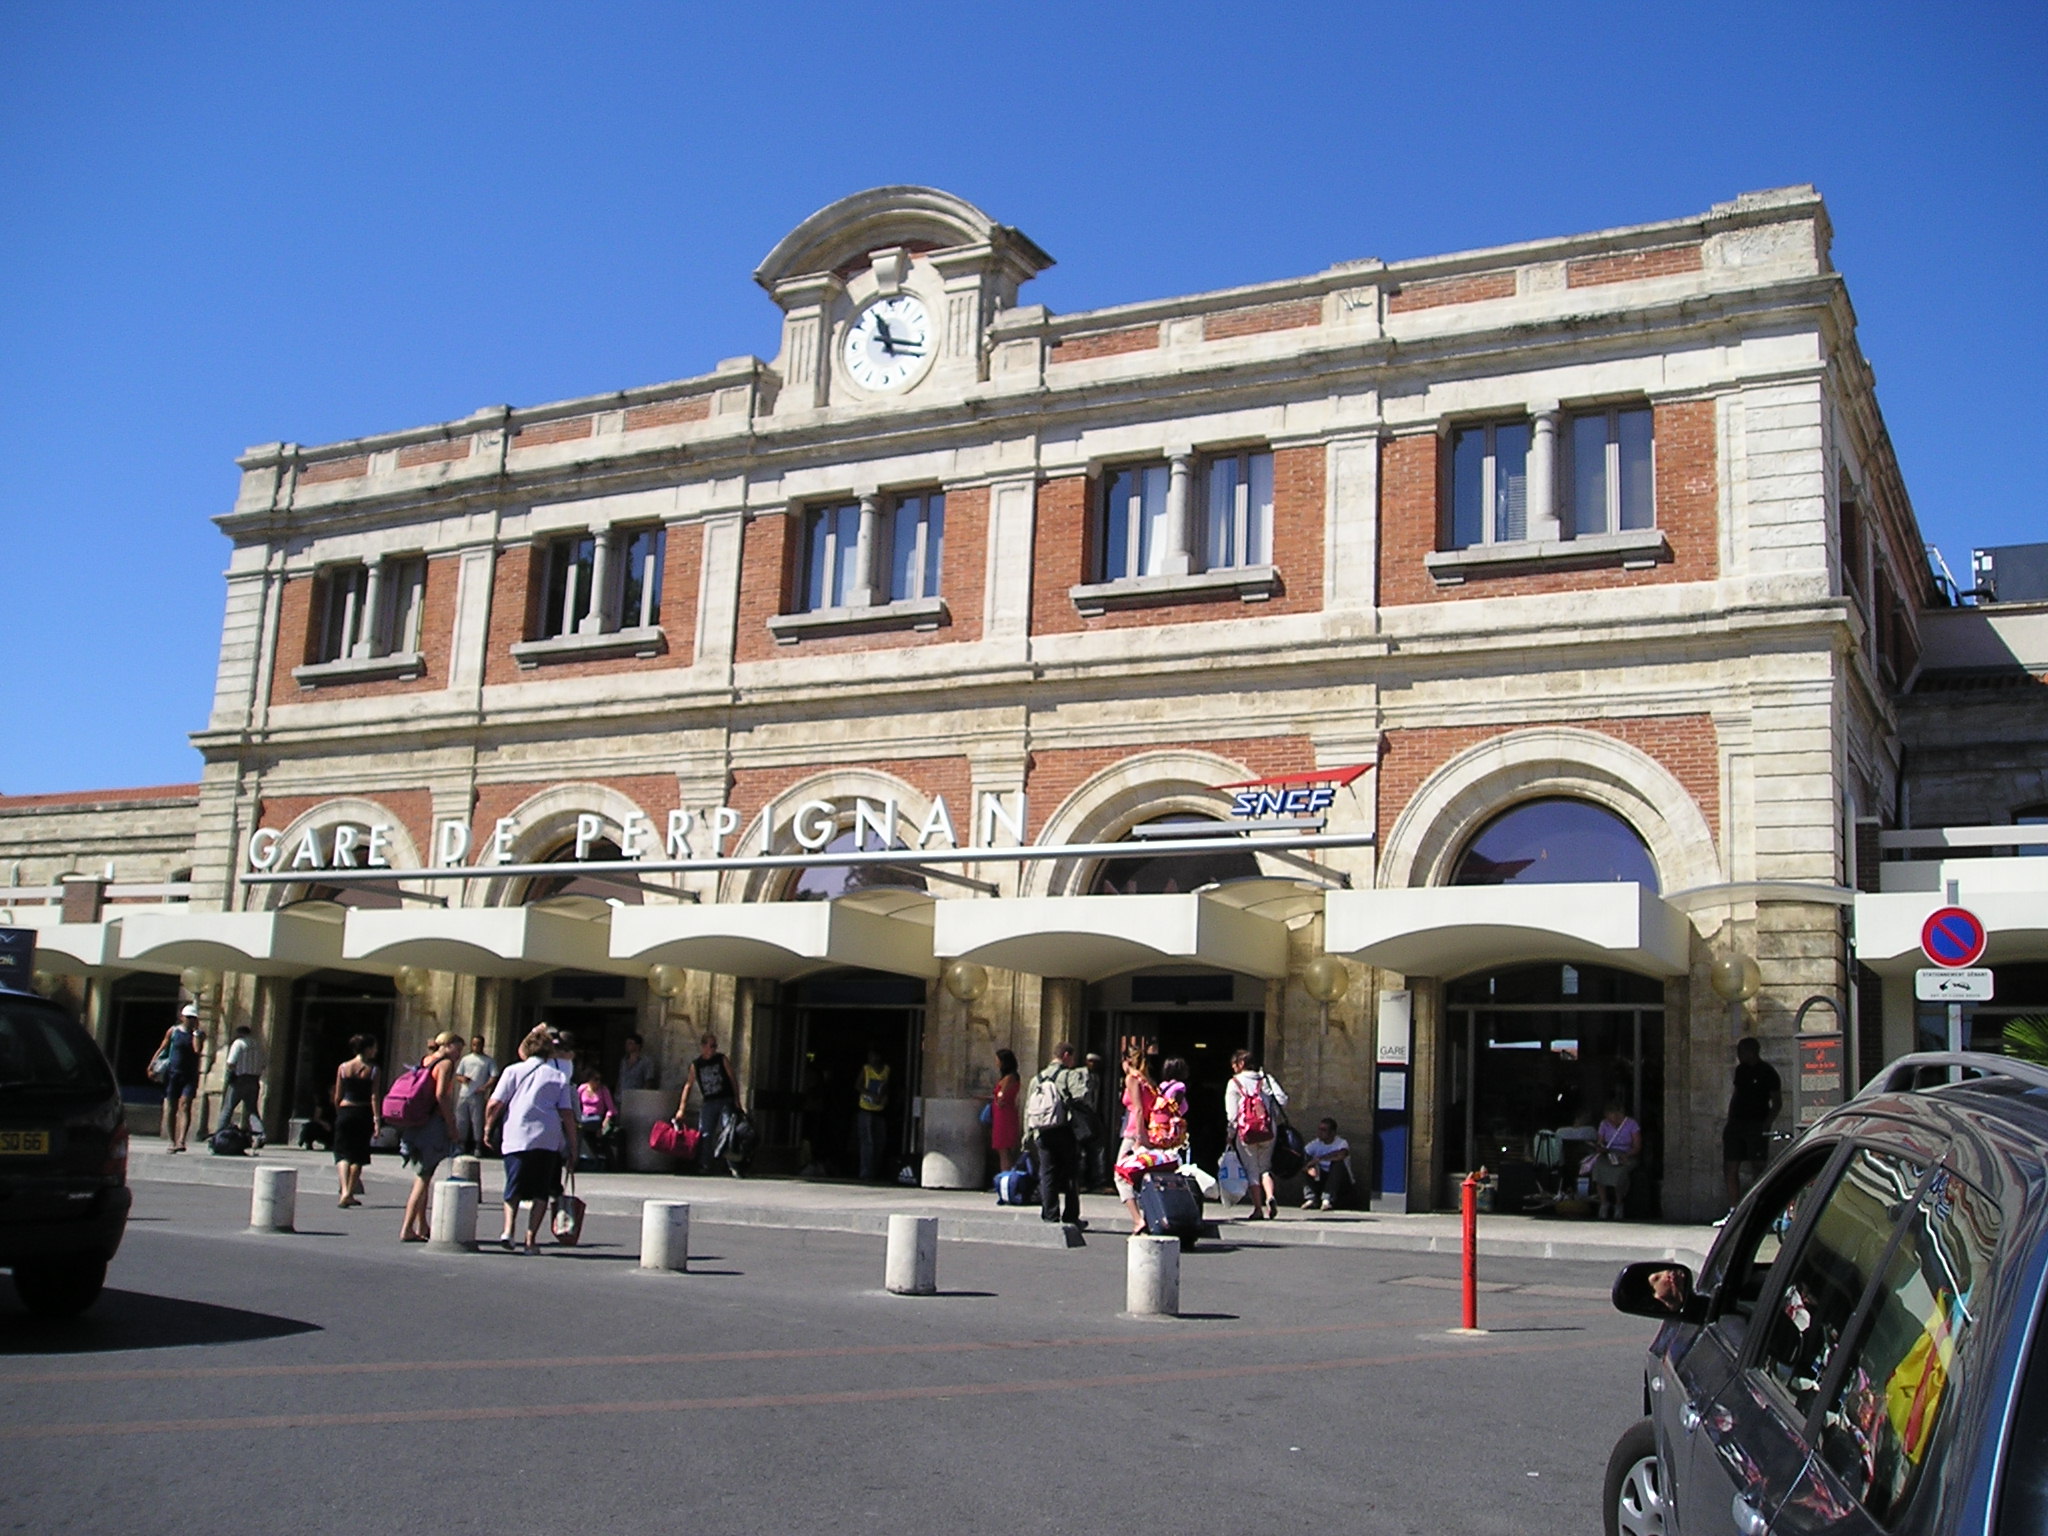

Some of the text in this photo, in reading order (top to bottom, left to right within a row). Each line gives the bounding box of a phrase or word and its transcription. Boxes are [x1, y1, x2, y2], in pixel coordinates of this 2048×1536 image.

[1231, 788, 1335, 816] SNCF
[249, 792, 1028, 869] GARE DE PERPIGNAN
[1380, 1046, 1406, 1056] GARE
[24, 1133, 41, 1151] 66
